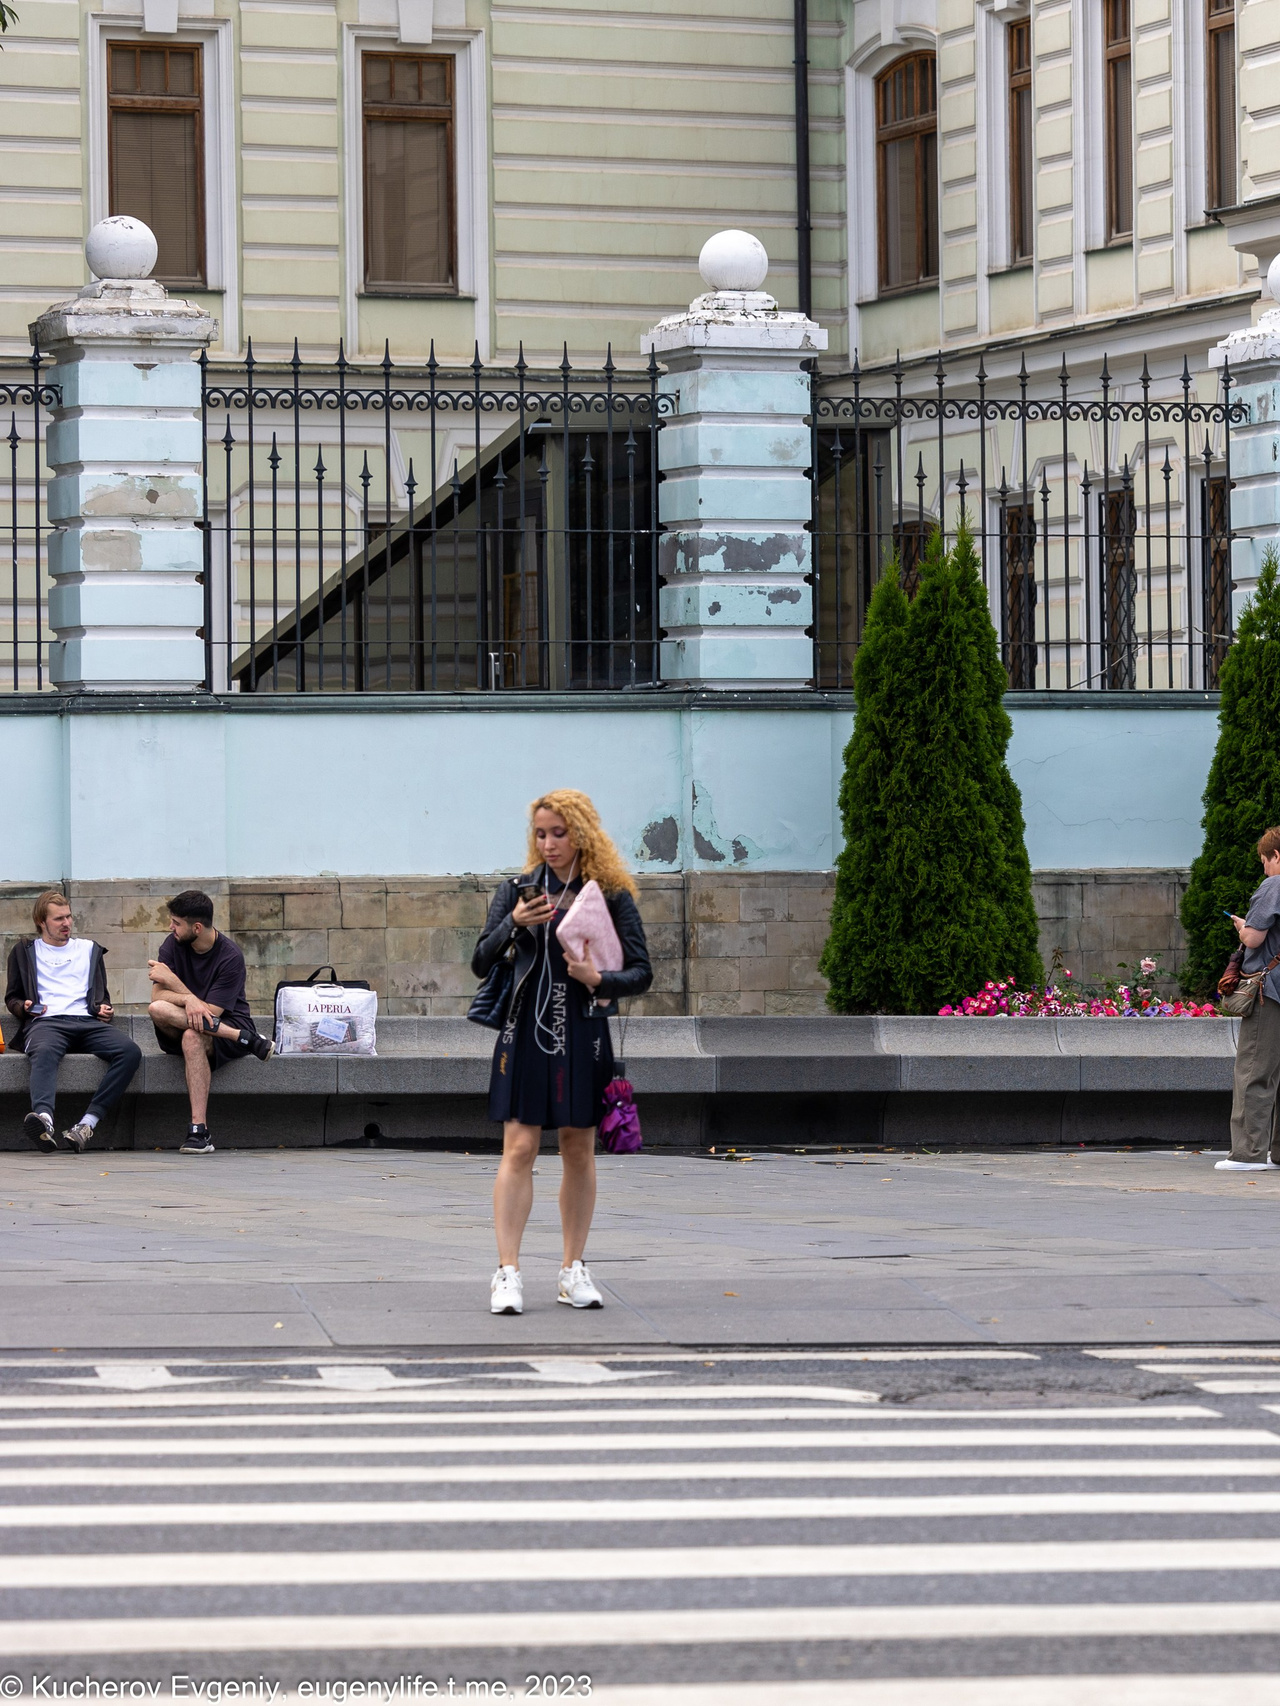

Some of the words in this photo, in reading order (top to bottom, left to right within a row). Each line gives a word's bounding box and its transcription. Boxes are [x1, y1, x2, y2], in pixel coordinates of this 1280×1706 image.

[308, 1003, 319, 1013] LA
[320, 1004, 352, 1014] PERLA
[552, 982, 567, 1056] FANTASTIC
